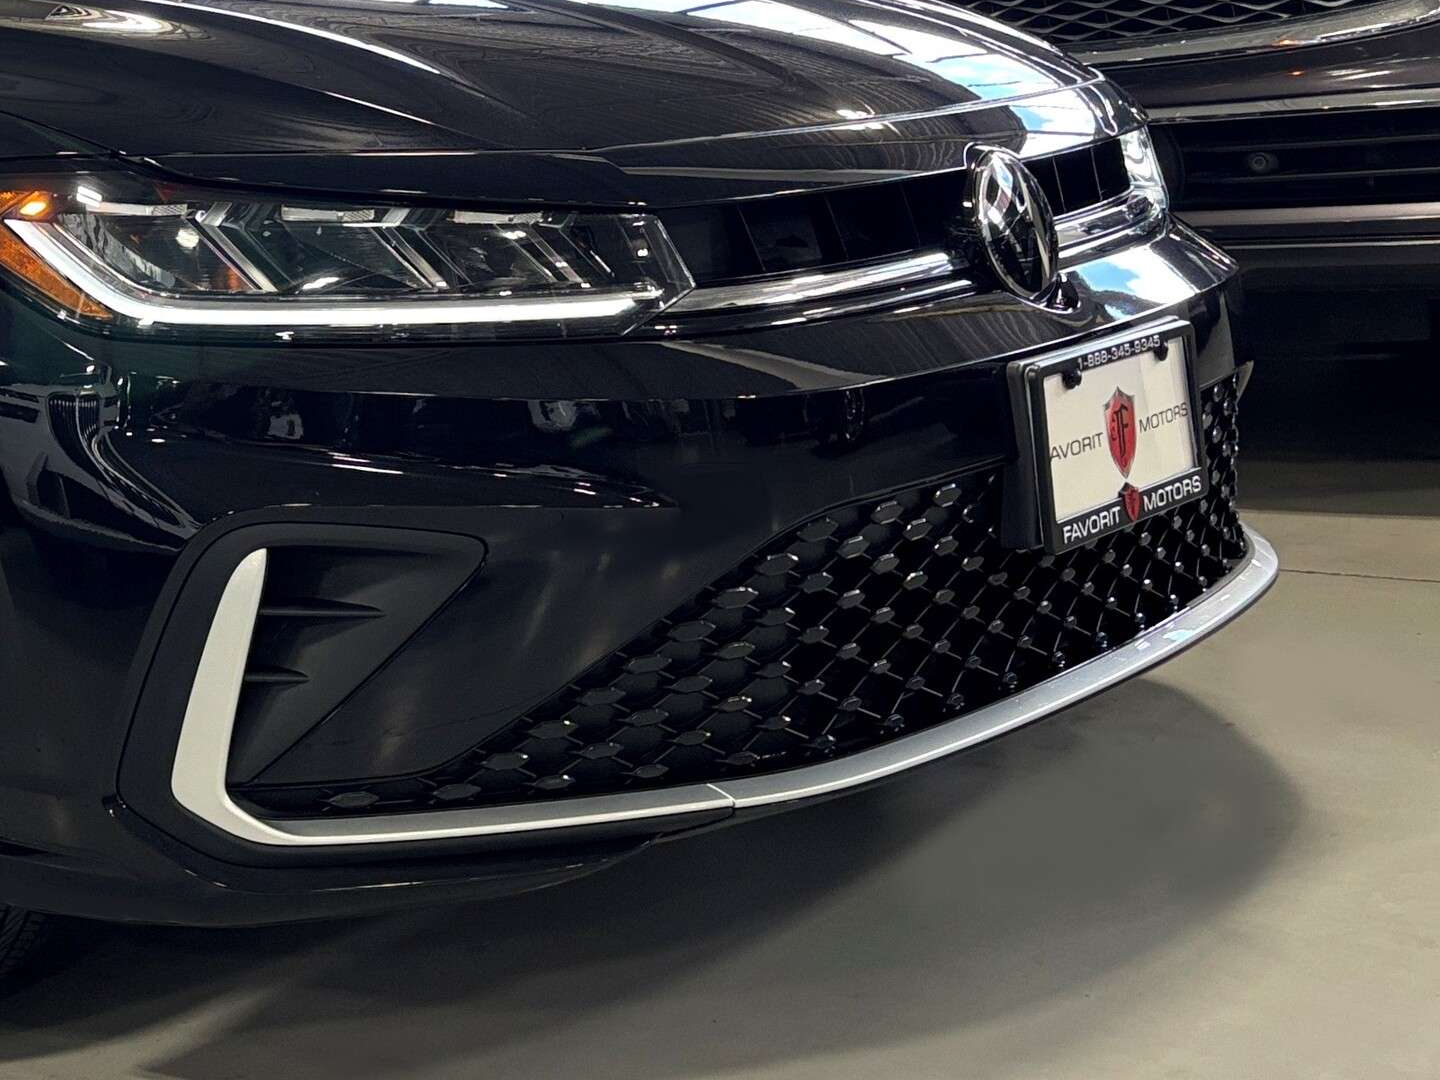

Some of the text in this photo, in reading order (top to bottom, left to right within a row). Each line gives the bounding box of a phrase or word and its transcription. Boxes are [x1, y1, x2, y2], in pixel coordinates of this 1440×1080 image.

[1077, 334, 1161, 370] 1-888-345-9345
[1050, 432, 1104, 462] AVORIT
[1138, 401, 1189, 434] MOTORS
[1062, 475, 1202, 545] FAVORIT MOTORS
